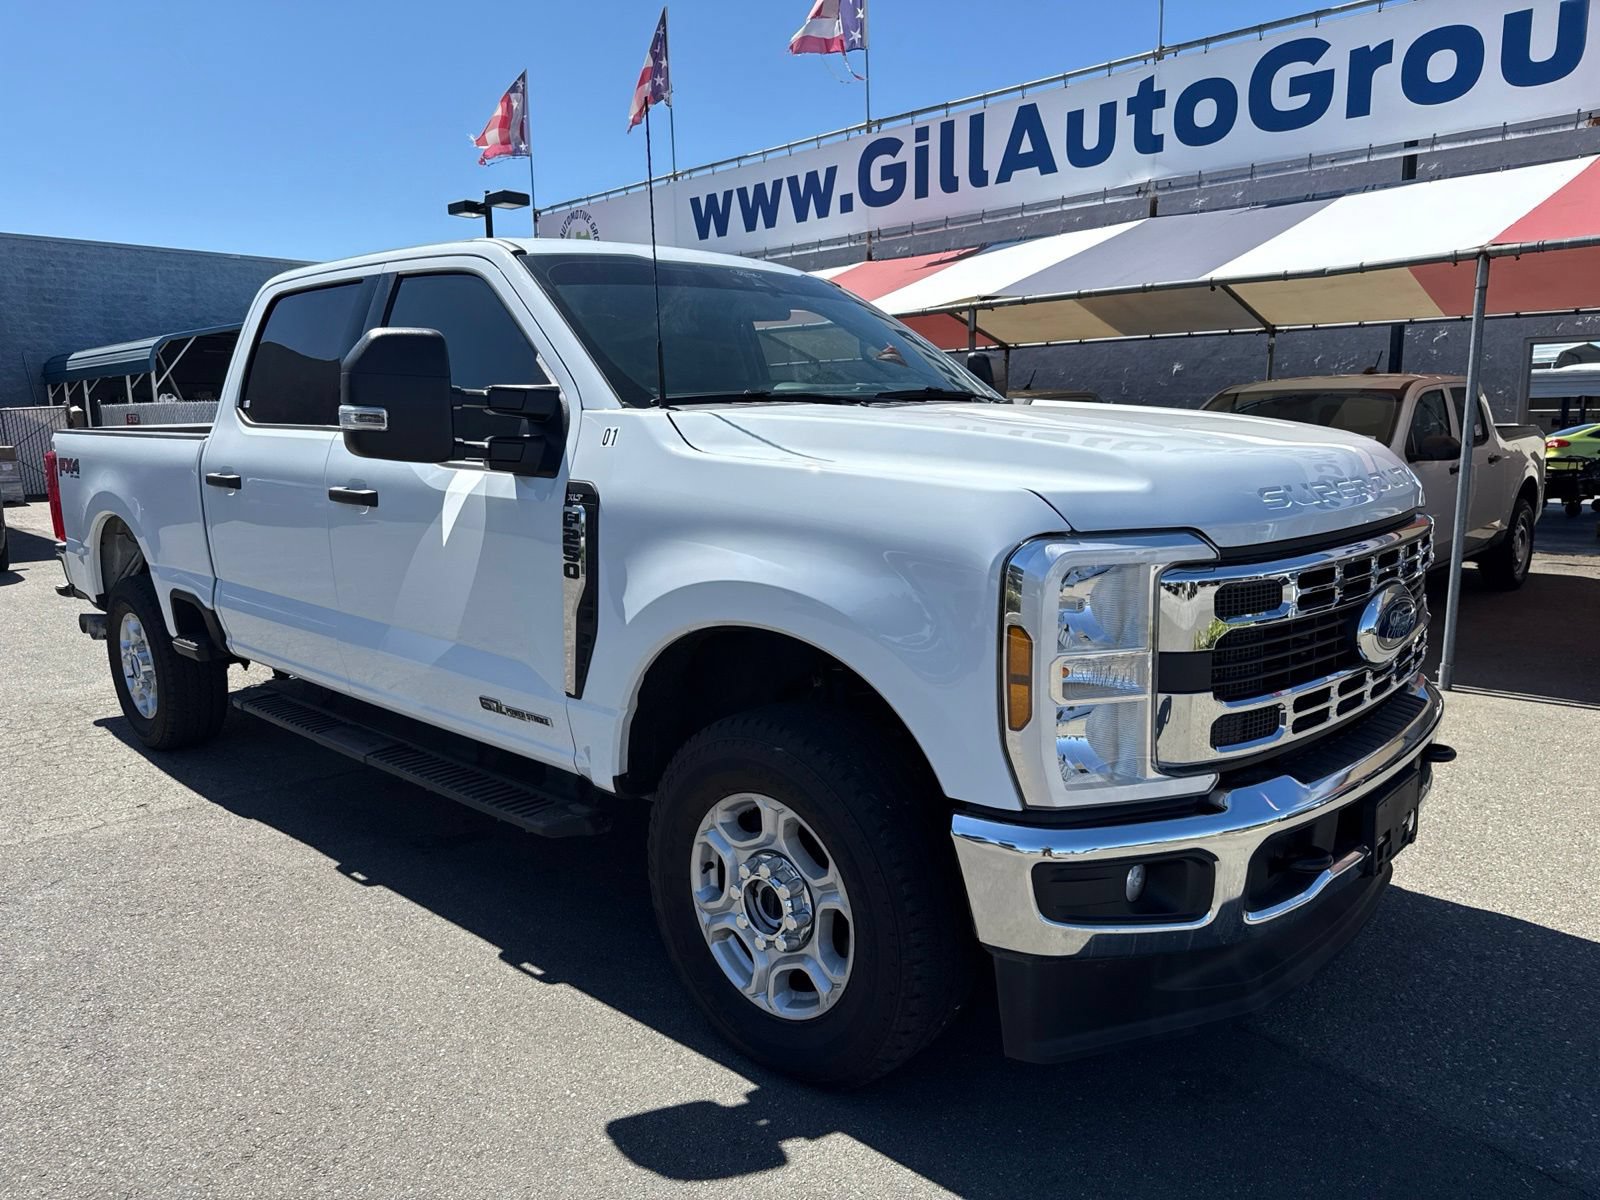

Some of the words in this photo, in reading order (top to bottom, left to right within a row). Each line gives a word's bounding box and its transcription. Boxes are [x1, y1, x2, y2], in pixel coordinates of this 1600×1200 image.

[690, 0, 1590, 241] www.GillAutoGrou
[560, 209, 592, 239] AUTOMOTIVE
[602, 427, 618, 446] 01
[59, 457, 80, 476] FX4
[568, 493, 583, 501] XLT
[1257, 478, 1377, 510] SUPER
